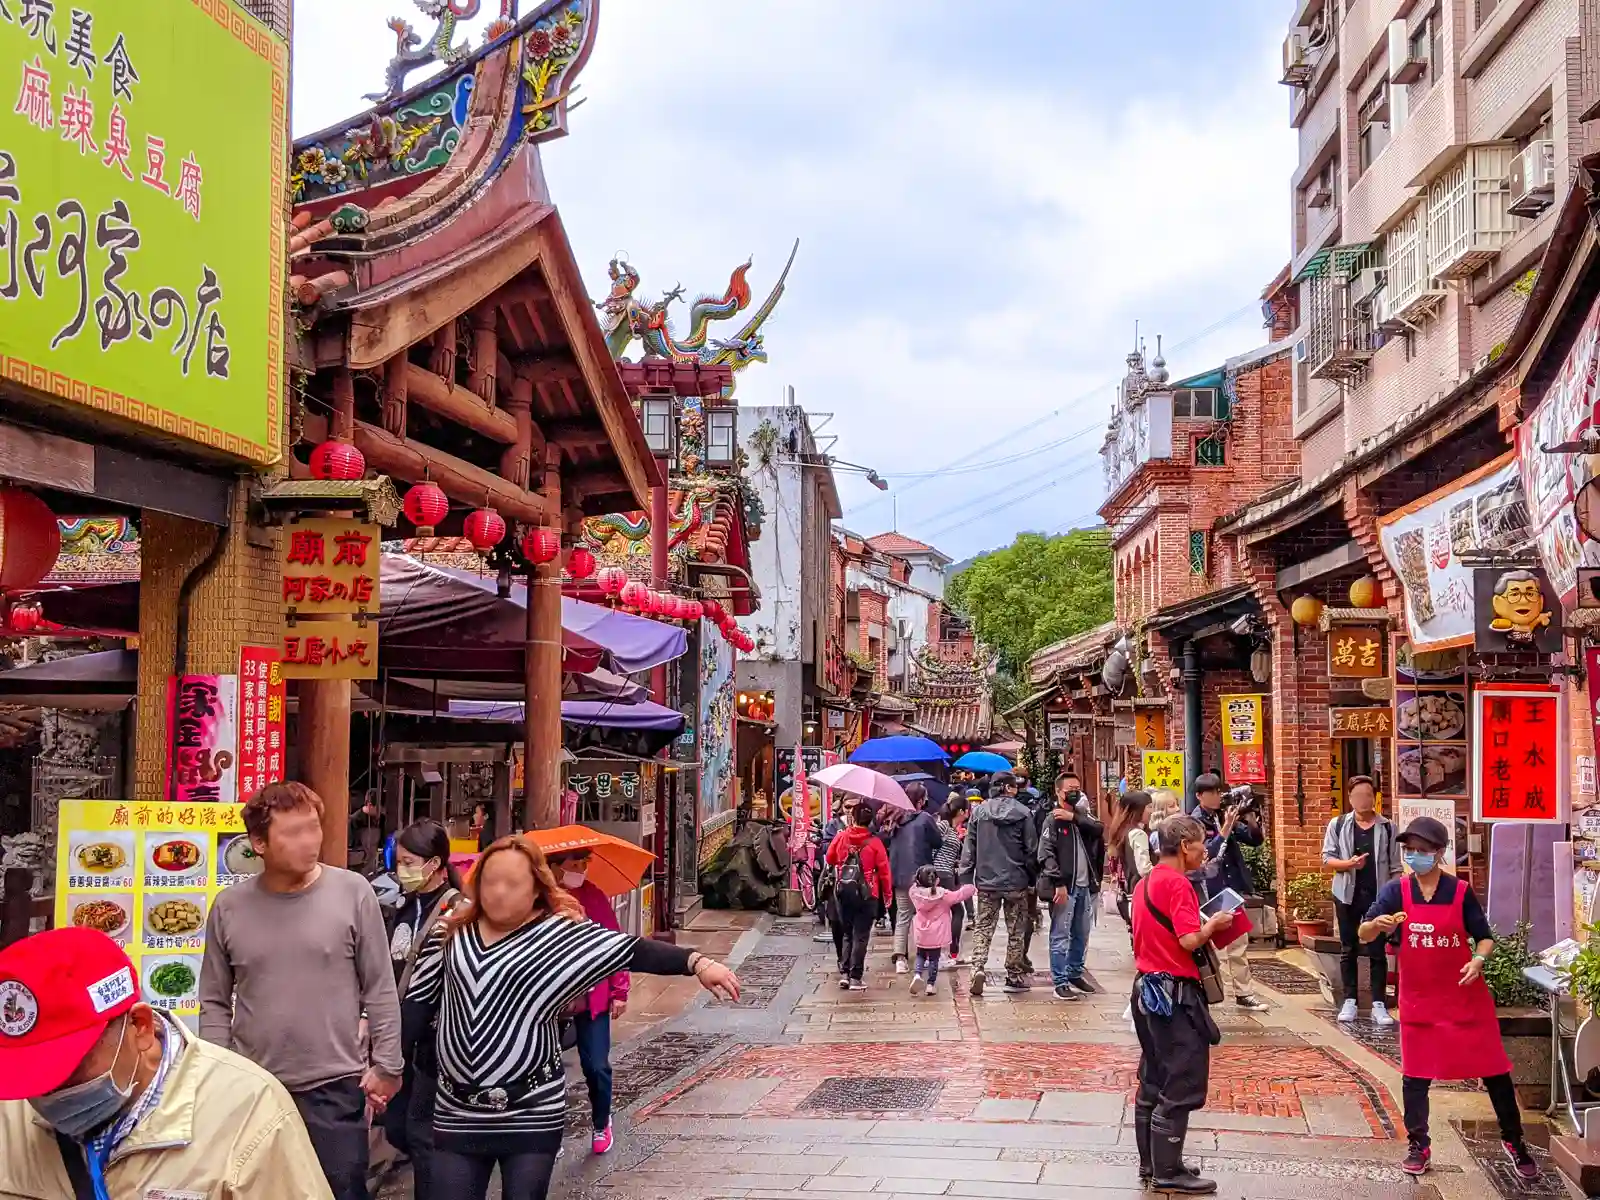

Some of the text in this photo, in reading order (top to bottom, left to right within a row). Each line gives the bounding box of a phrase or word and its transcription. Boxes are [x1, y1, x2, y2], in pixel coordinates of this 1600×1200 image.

[15, 55, 202, 219] 麻辣臭豆腐
[286, 528, 373, 568] 廟前
[282, 574, 374, 603] 阿家の店
[281, 636, 371, 666] 豆腐小吃
[1331, 637, 1381, 668] 萬吉
[268, 662, 282, 722] 感謝
[243, 659, 256, 793] 33家的其中一家
[1333, 711, 1391, 733] 豆腐美食
[1488, 700, 1512, 810] 廟口老店
[1523, 700, 1546, 812] 王水成
[568, 771, 641, 798] 七里香
[1148, 778, 1181, 788] 臭豆腐
[1156, 765, 1171, 778] 炸
[109, 804, 241, 827] 廟前的好滋味
[122, 877, 133, 888] 60
[143, 875, 185, 888] 麻辣臭豆腐
[196, 877, 207, 888] 60
[147, 936, 183, 949] 滷桂竹筍
[1408, 933, 1460, 949] 寶桂的店
[179, 999, 196, 1009] 100
